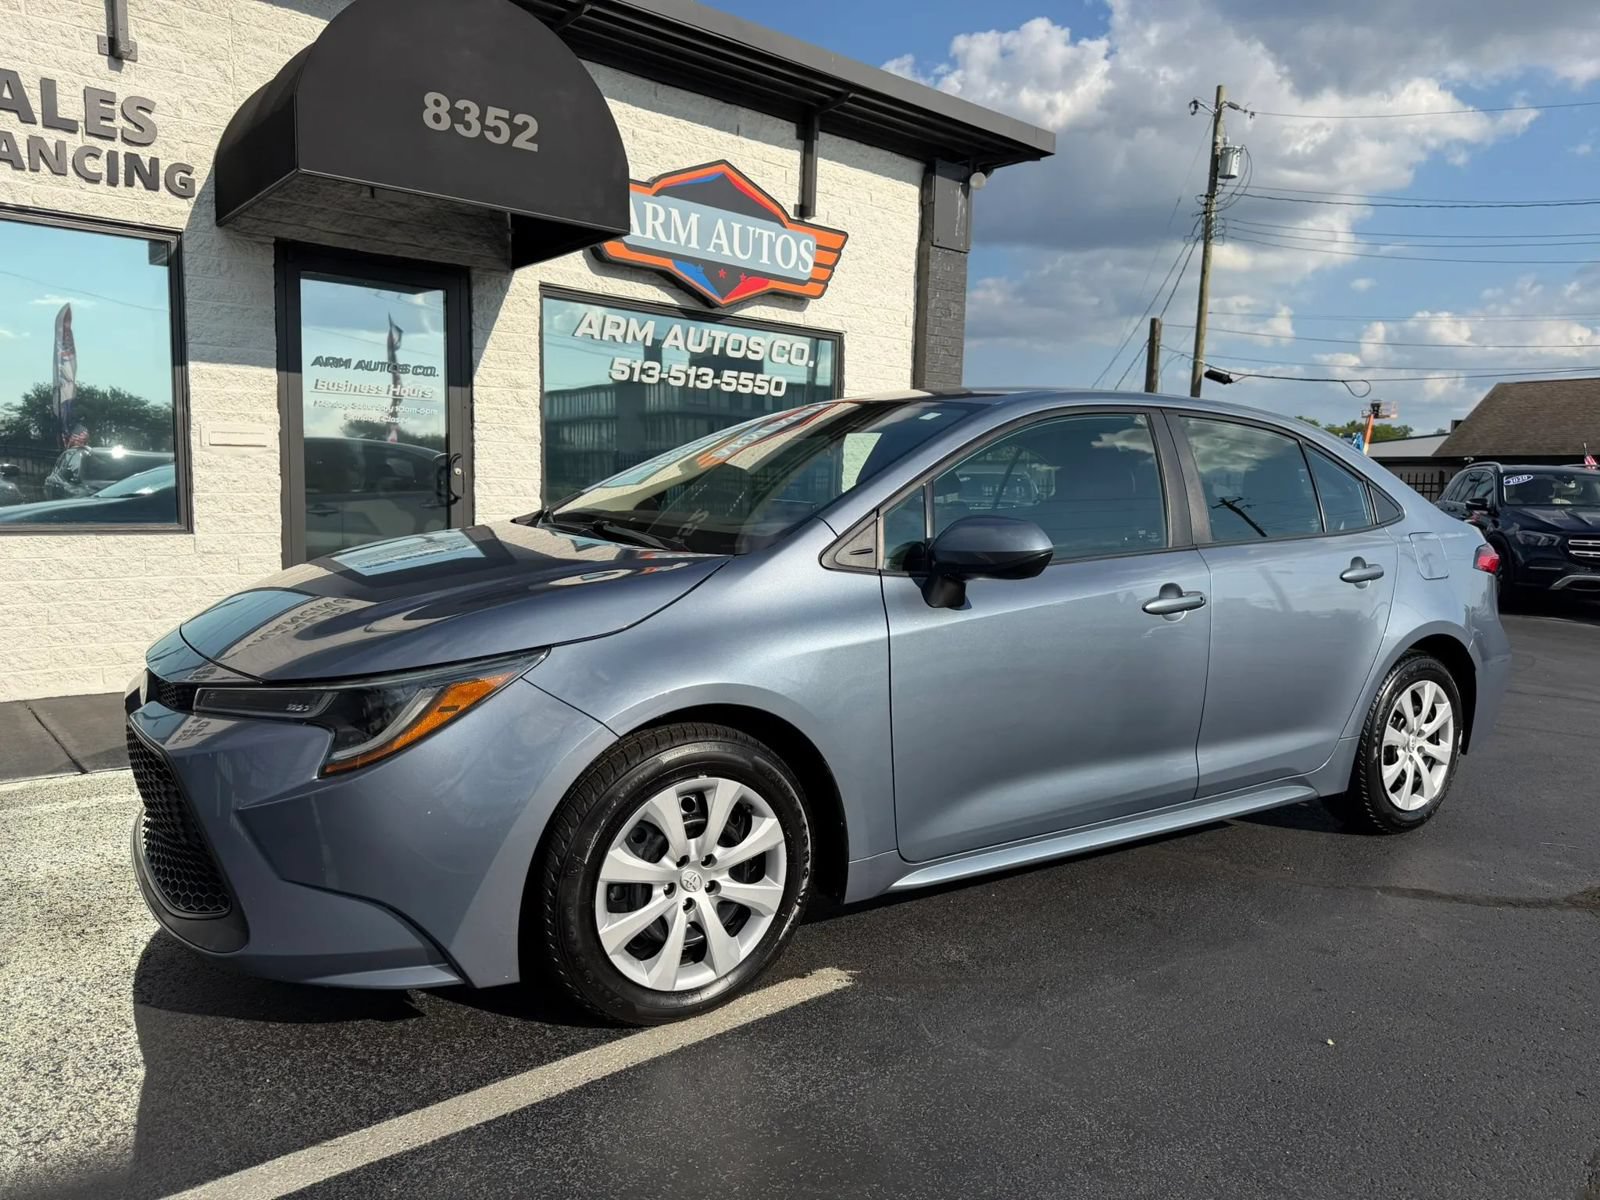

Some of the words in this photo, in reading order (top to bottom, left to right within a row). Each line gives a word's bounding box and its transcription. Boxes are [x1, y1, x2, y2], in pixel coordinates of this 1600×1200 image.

[422, 91, 539, 152] 8352
[709, 218, 815, 274] AUTOS
[573, 311, 656, 347] ARM
[661, 324, 766, 361] AUTOS
[769, 340, 815, 368] CO.
[311, 355, 353, 369] ARM
[353, 359, 411, 374] AUTOS
[411, 364, 439, 377] CO.
[313, 378, 384, 396] Business
[386, 384, 434, 399] Hours
[608, 357, 787, 397] 513-513-5550
